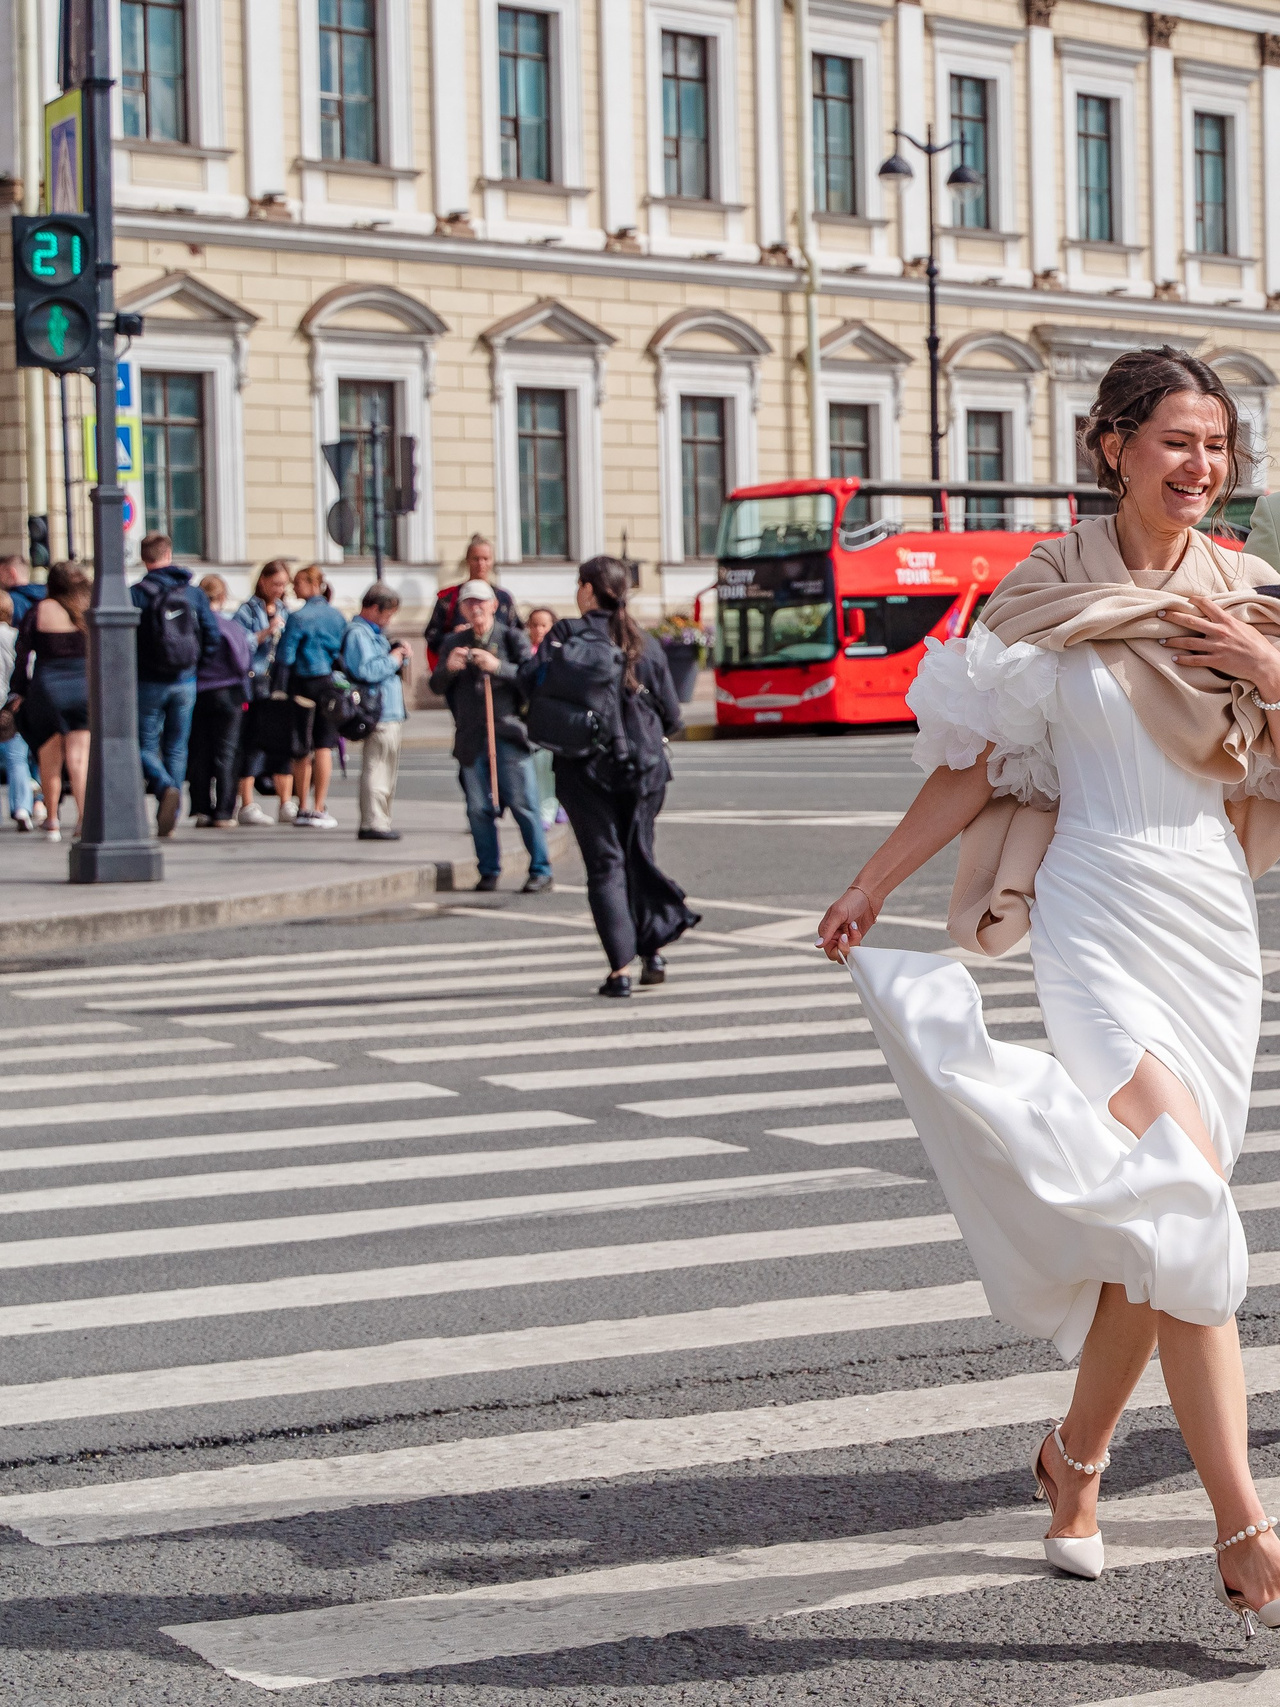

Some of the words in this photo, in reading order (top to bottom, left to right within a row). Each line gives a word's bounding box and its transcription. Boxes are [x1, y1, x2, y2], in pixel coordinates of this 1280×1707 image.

[32, 231, 81, 276] 21
[906, 552, 936, 568] CITY
[895, 568, 931, 585] TOUR
